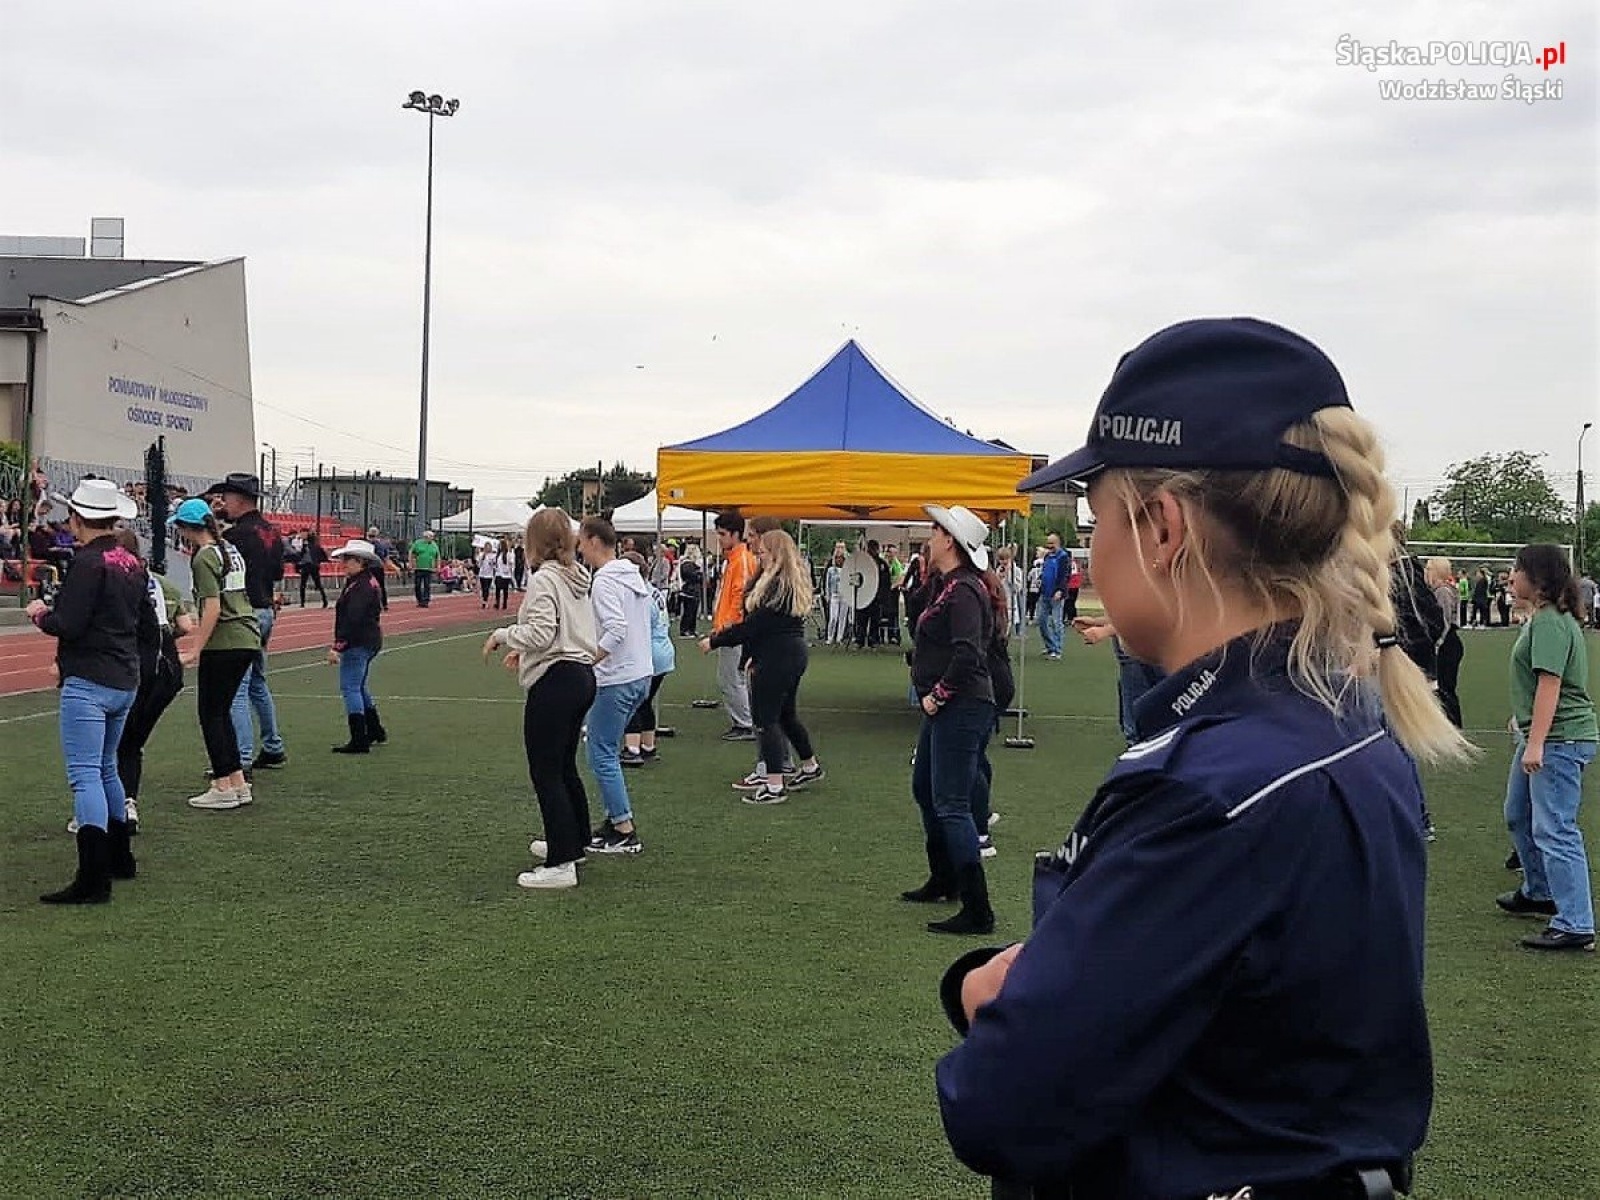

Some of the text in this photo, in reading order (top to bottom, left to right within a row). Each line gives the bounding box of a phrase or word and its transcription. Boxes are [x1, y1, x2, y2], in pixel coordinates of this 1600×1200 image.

[166, 413, 193, 432] SPORTU
[1099, 415, 1181, 445] POLICJA
[1171, 669, 1217, 717] POLICJA
